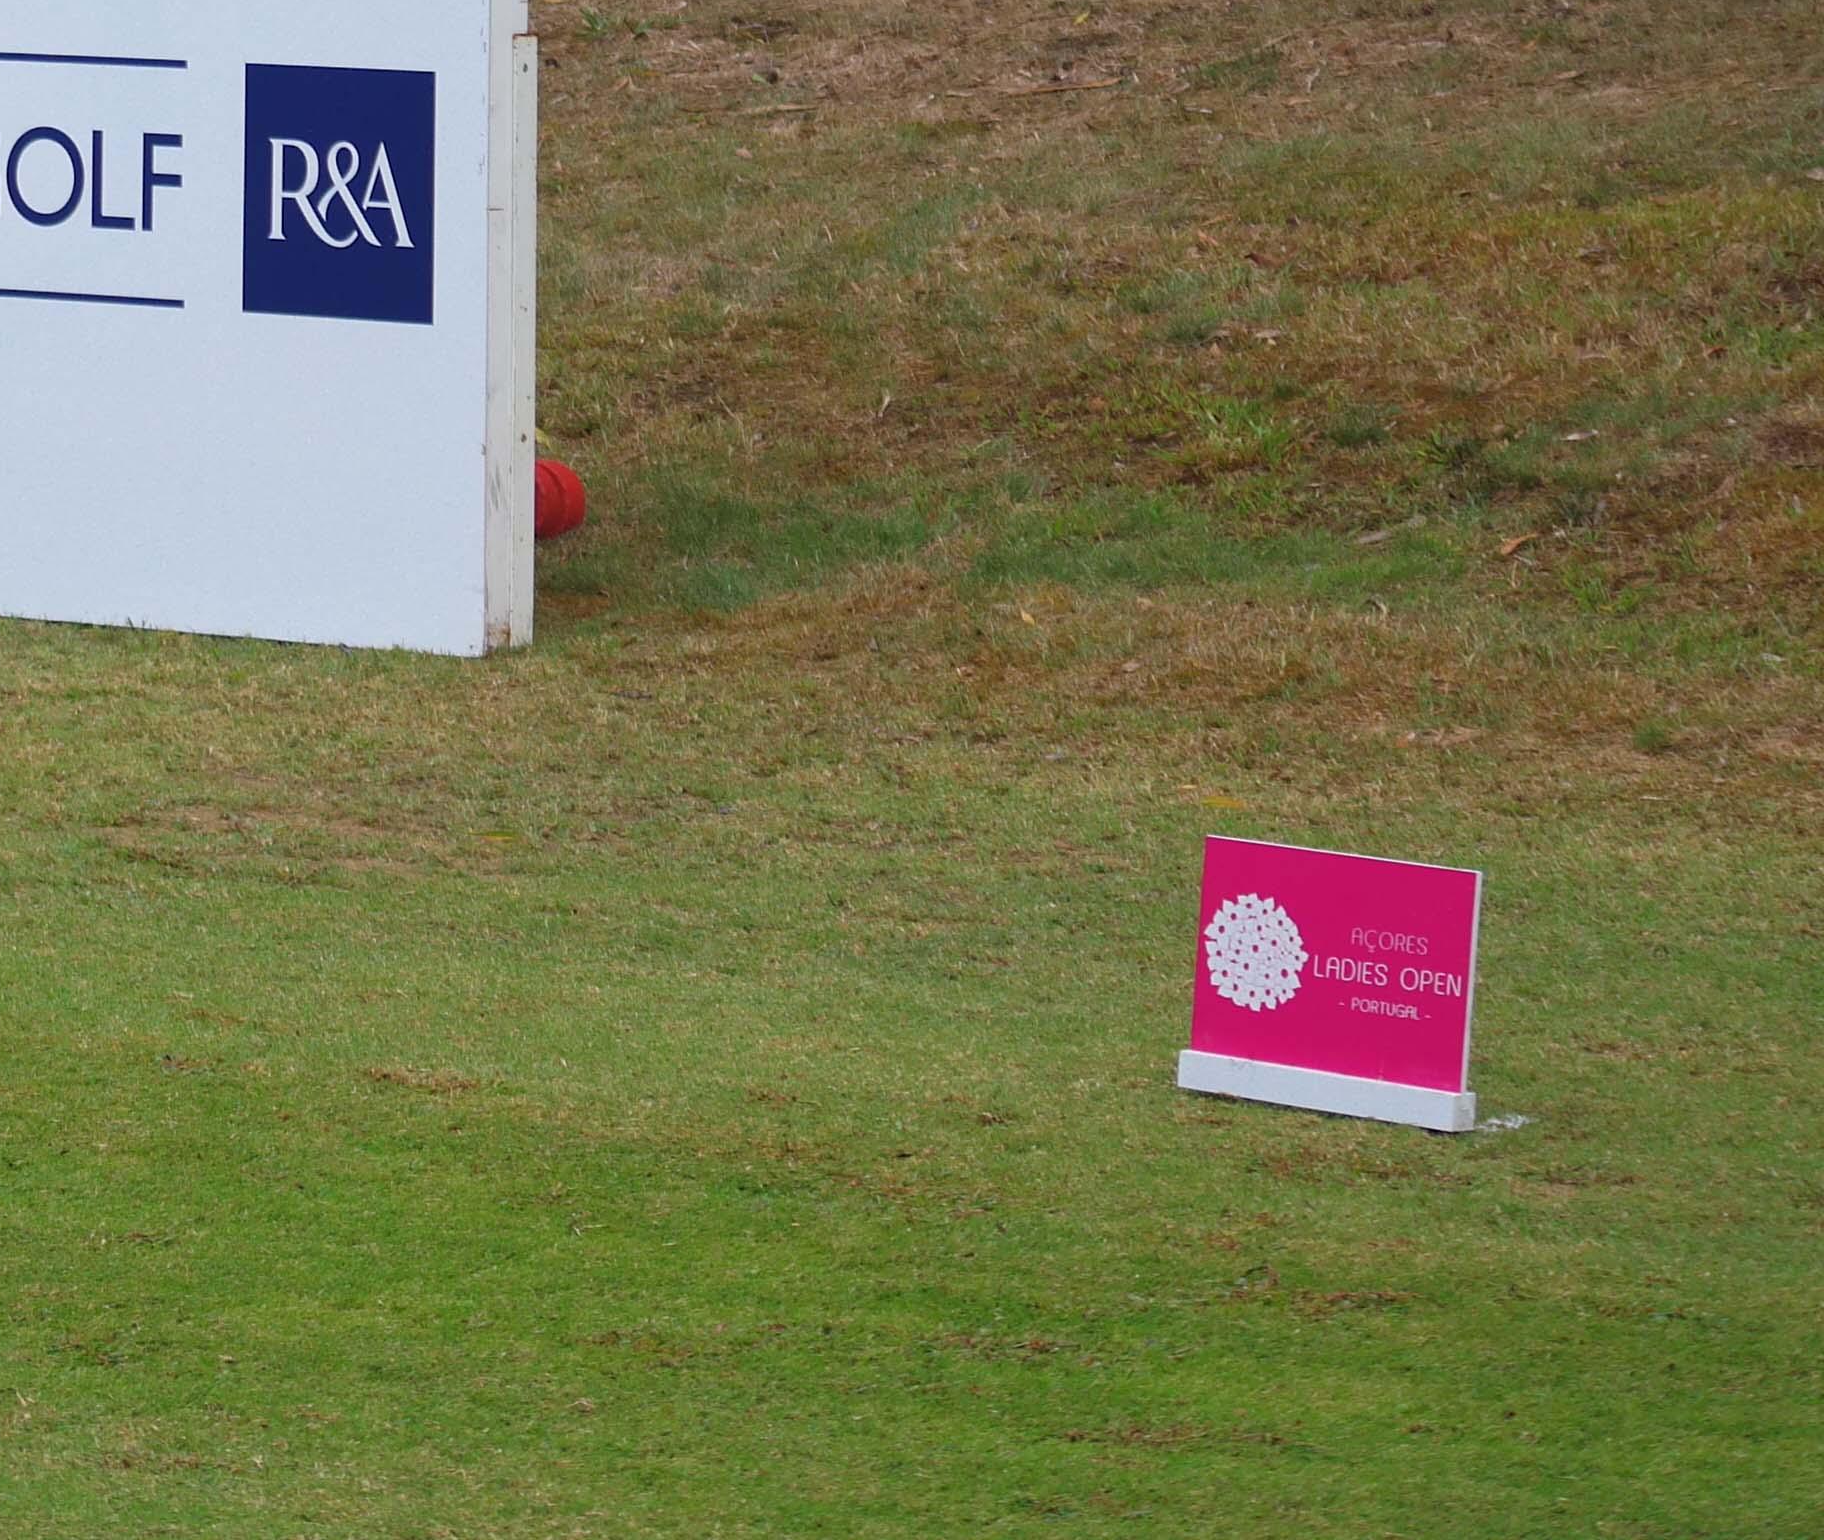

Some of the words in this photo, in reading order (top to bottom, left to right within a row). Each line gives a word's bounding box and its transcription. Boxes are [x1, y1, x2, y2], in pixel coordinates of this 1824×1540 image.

[267, 137, 415, 248] R&A
[1351, 927, 1429, 956] AÇORES
[1313, 954, 1389, 987] LADIES
[1399, 967, 1462, 997] OPEN
[1350, 996, 1421, 1021] PORTUGAL
